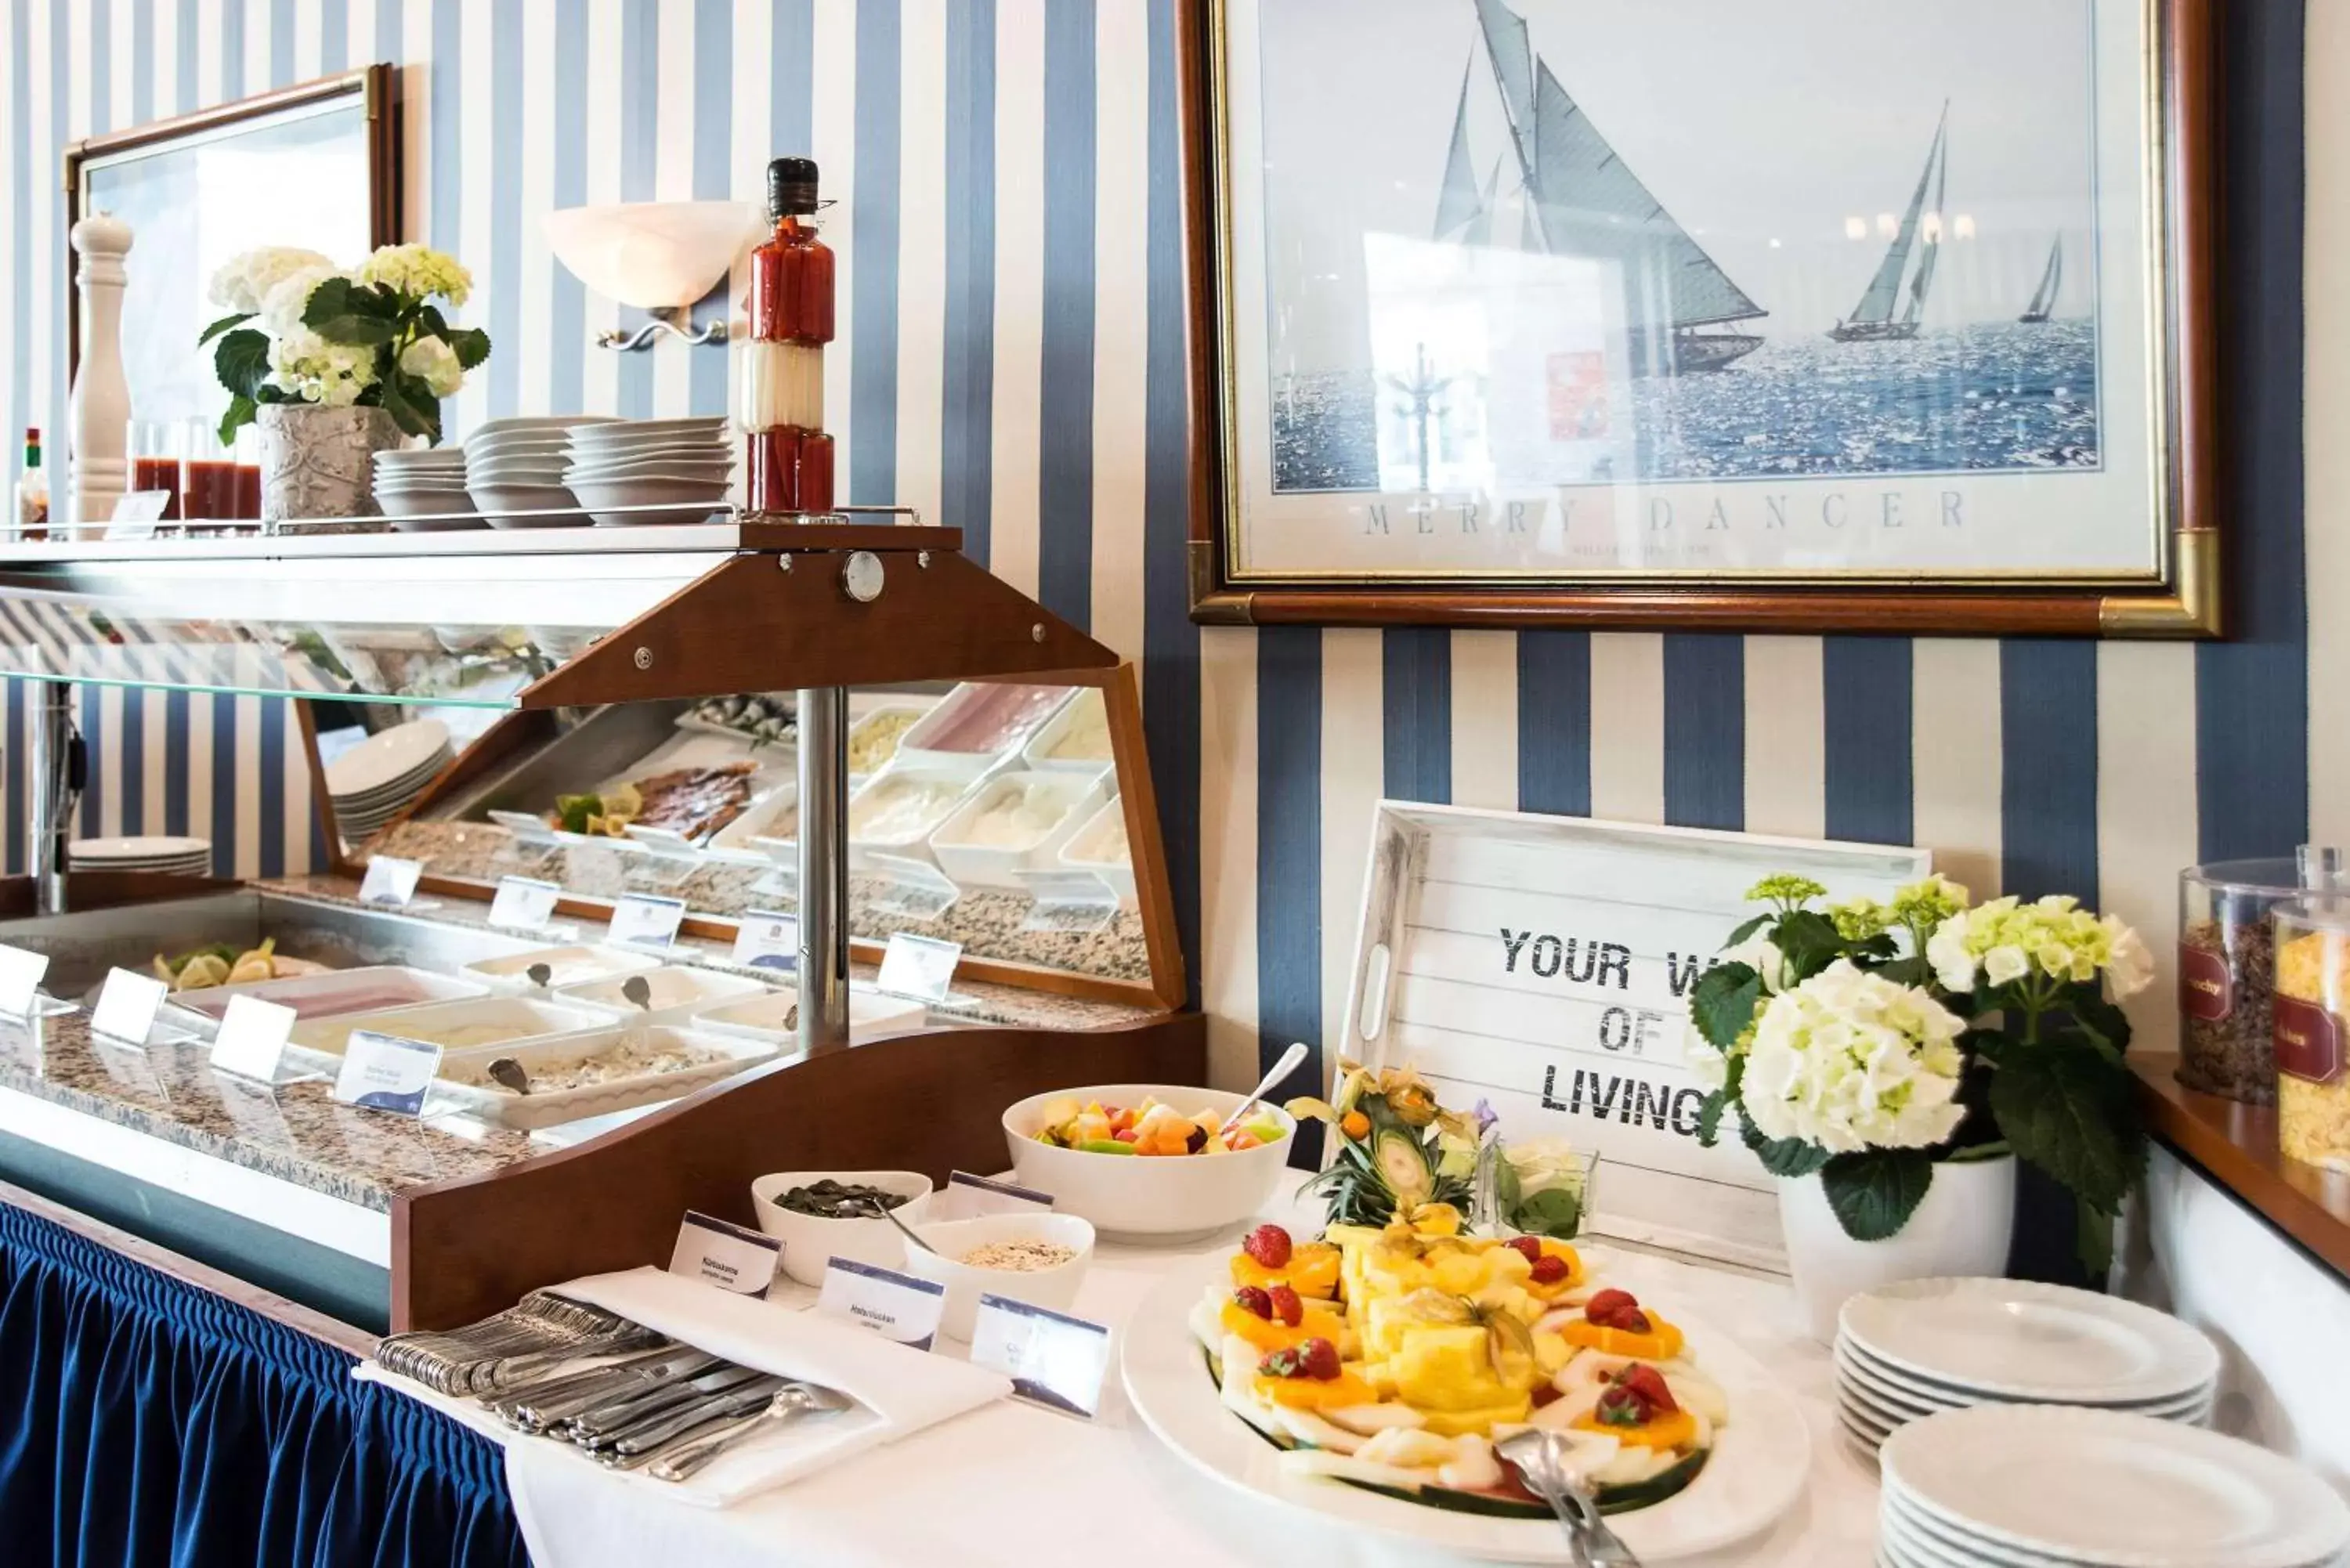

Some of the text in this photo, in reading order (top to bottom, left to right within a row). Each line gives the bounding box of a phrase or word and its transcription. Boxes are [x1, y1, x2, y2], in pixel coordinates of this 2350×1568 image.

[1365, 490, 1965, 537] MERRY DANCER
[1499, 927, 1631, 990] YOUR
[1599, 1006, 1663, 1055] OF
[1542, 1065, 1704, 1137] LIVING
